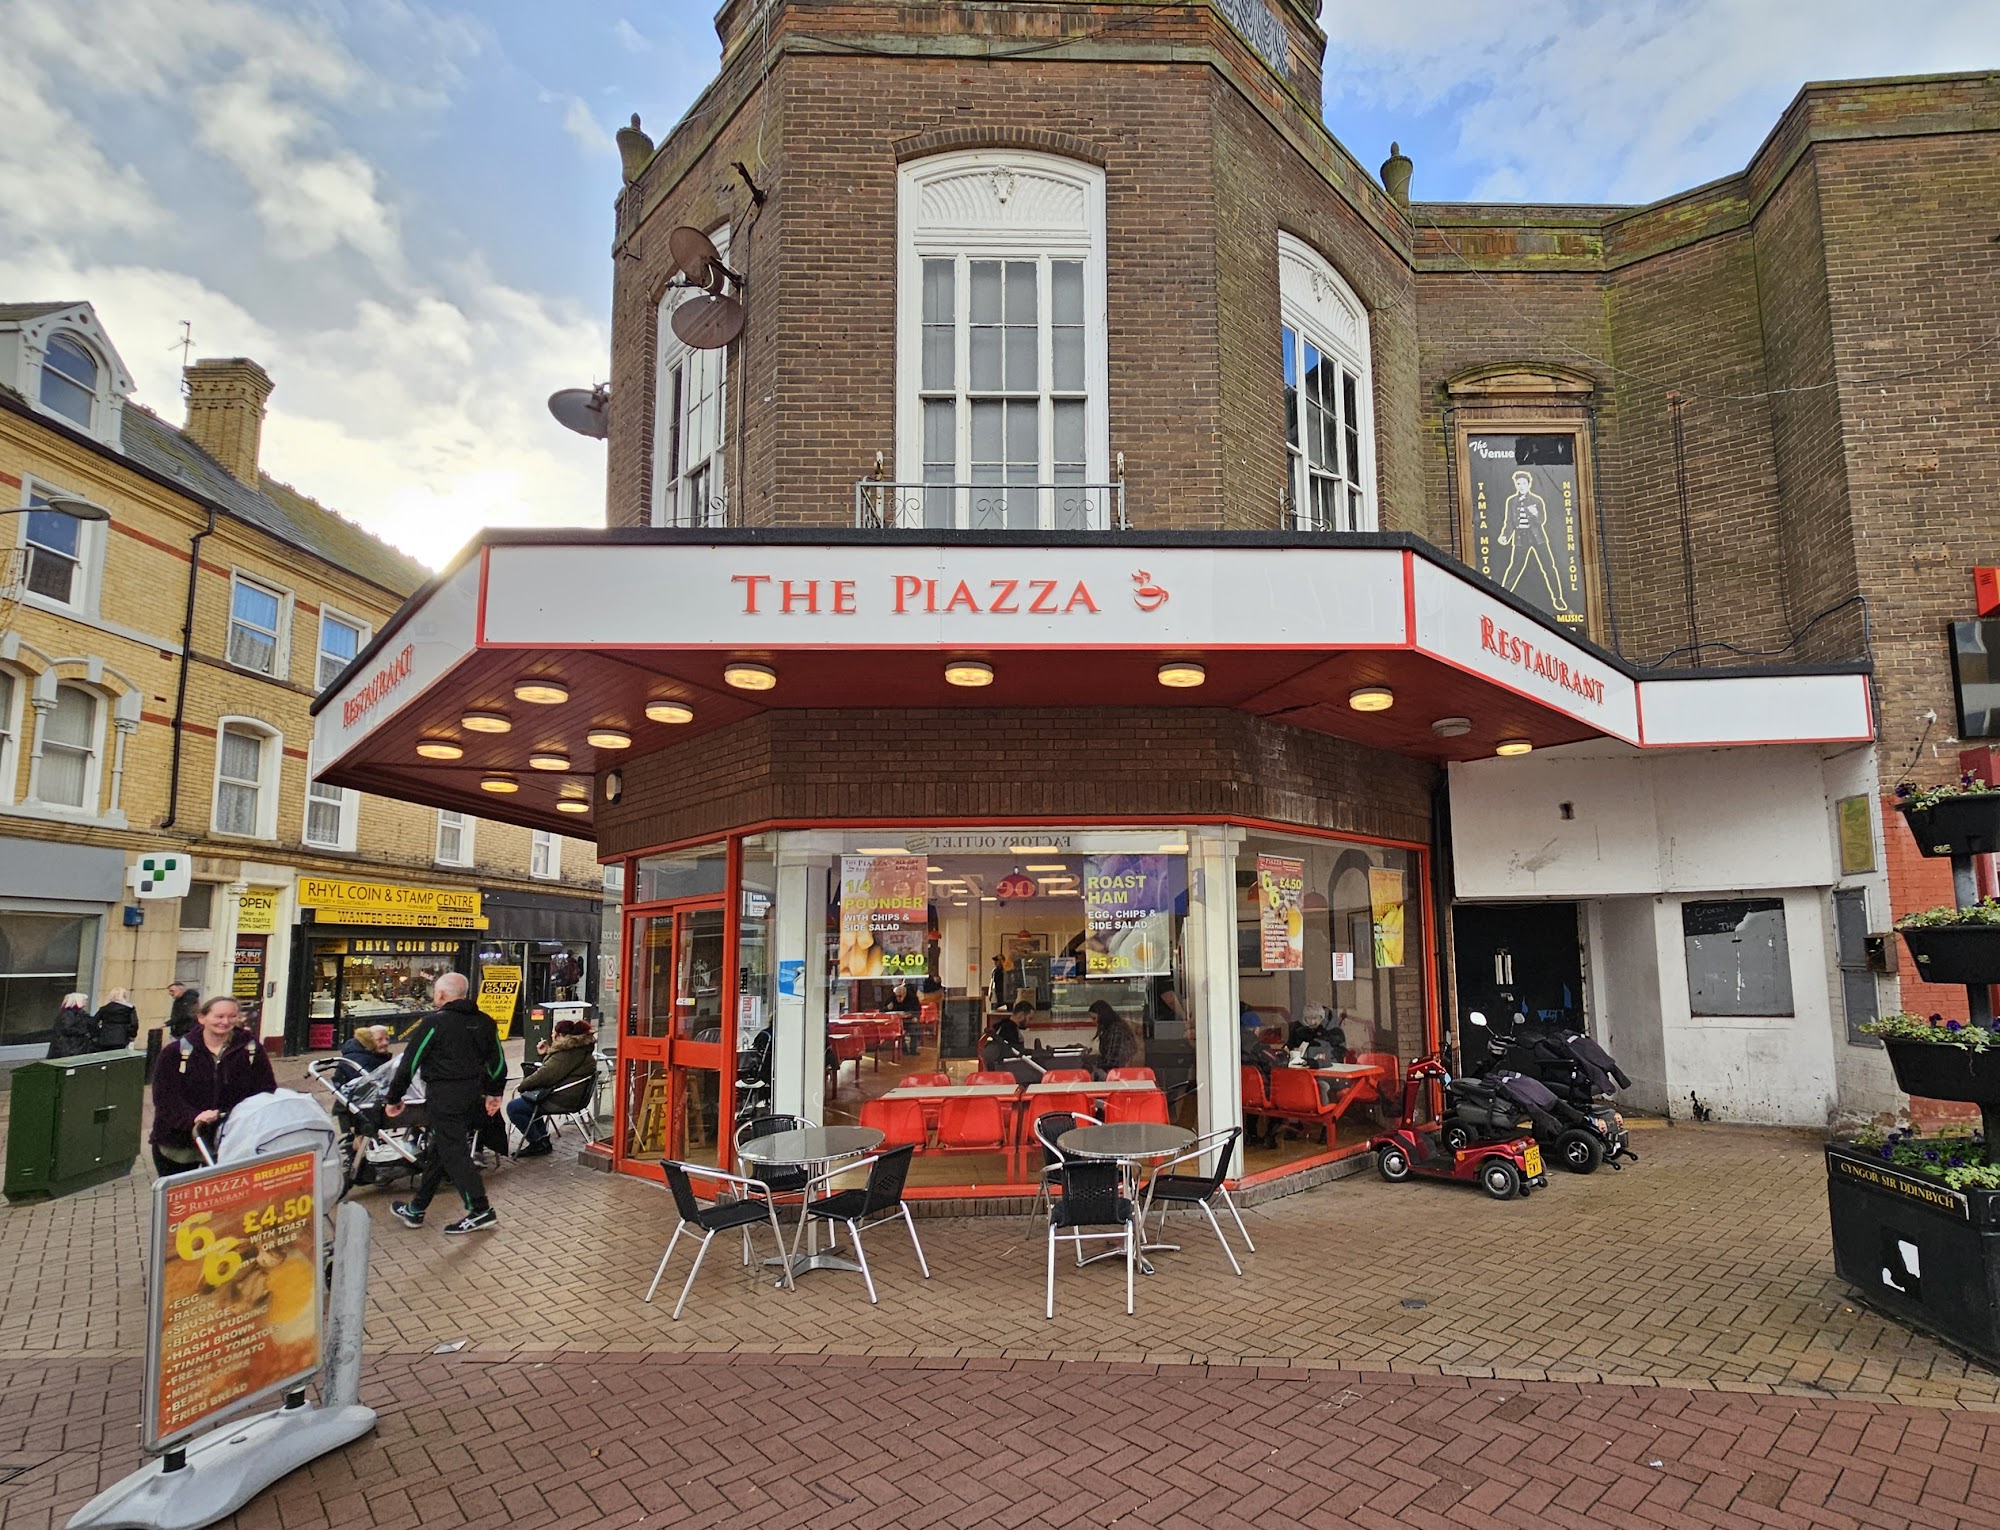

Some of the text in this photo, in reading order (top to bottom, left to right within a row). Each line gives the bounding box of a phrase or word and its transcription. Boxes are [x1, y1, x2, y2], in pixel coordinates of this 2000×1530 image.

[1469, 440, 1488, 452] The
[1480, 448, 1515, 459] Venue
[1477, 482, 1492, 580] TAMLA MOTO
[1562, 481, 1578, 591] NORTHERN SOUL
[731, 574, 1101, 615] THE PIAZZA
[1556, 614, 1584, 623] MUSIC
[1480, 614, 1605, 705] RESTAURANT
[343, 643, 415, 731] RESTAURANT
[845, 879, 872, 893] 1/4
[1087, 875, 1147, 889] ROAST
[239, 898, 271, 909] OPEN
[308, 881, 474, 908] RHYL COIN & STAMP CENTRE
[844, 896, 924, 910] POUNDER
[1088, 890, 1128, 904] HAM
[337, 911, 382, 924] WANTED
[385, 913, 414, 925] SCRAP
[417, 915, 437, 926] GOLD
[447, 916, 474, 928] SILVER
[844, 913, 910, 922] WITH CHIPS &
[1088, 909, 1157, 919] EGG, CHIPS &
[868, 923, 900, 931] SALAD
[1088, 921, 1148, 930] SIDE SALAD
[355, 940, 390, 951] RHYL
[396, 940, 425, 952] COIN
[430, 941, 460, 952] SHOP
[882, 954, 925, 966] £4.60
[1089, 957, 1130, 969] £5.30
[253, 1160, 311, 1182] BREAKFAST
[167, 1189, 190, 1203] THE
[193, 1177, 249, 1200] PIAZZA
[1840, 1163, 1955, 1209] CYNGOR SIR DDINBYCH
[189, 1189, 250, 1211] RESTAURANT
[242, 1194, 314, 1234] £4.50
[176, 1210, 216, 1261] 6
[250, 1219, 307, 1244] WITH TOAST
[262, 1233, 298, 1251] OR B&B
[204, 1236, 242, 1287] 6
[173, 1294, 199, 1309] EGG
[173, 1301, 216, 1322] BACON
[172, 1304, 269, 1348] BLACK PUDDING
[173, 1307, 232, 1335] SAUSAGE
[172, 1322, 255, 1360] HASH BROWN
[171, 1342, 266, 1386] FRESH TOMATO
[172, 1348, 221, 1373] TINNED
[171, 1359, 251, 1399] MUSHROOMS
[171, 1387, 210, 1411] BEANS
[171, 1383, 248, 1425] FRIED BREAD
